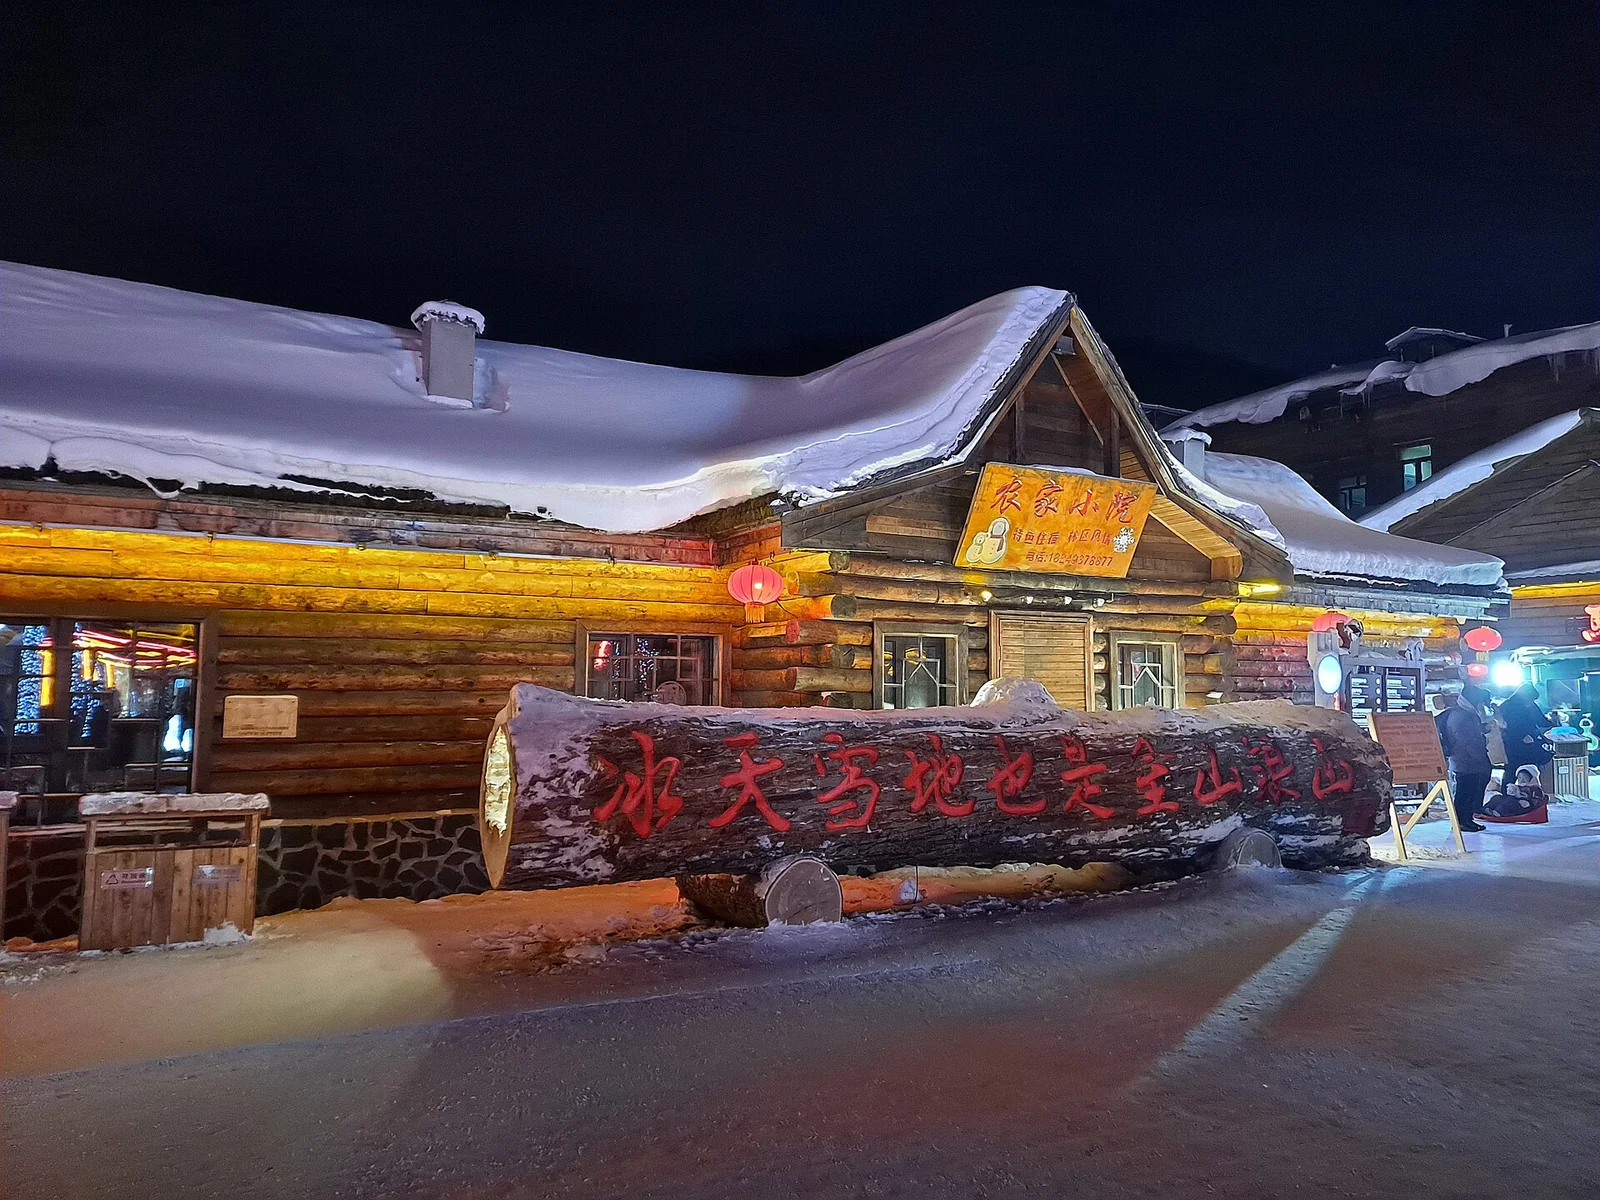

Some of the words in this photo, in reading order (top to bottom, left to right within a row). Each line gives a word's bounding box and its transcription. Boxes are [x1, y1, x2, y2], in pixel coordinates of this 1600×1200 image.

[990, 475, 1138, 523] 农家小院
[1012, 527, 1060, 546] 特色住宿
